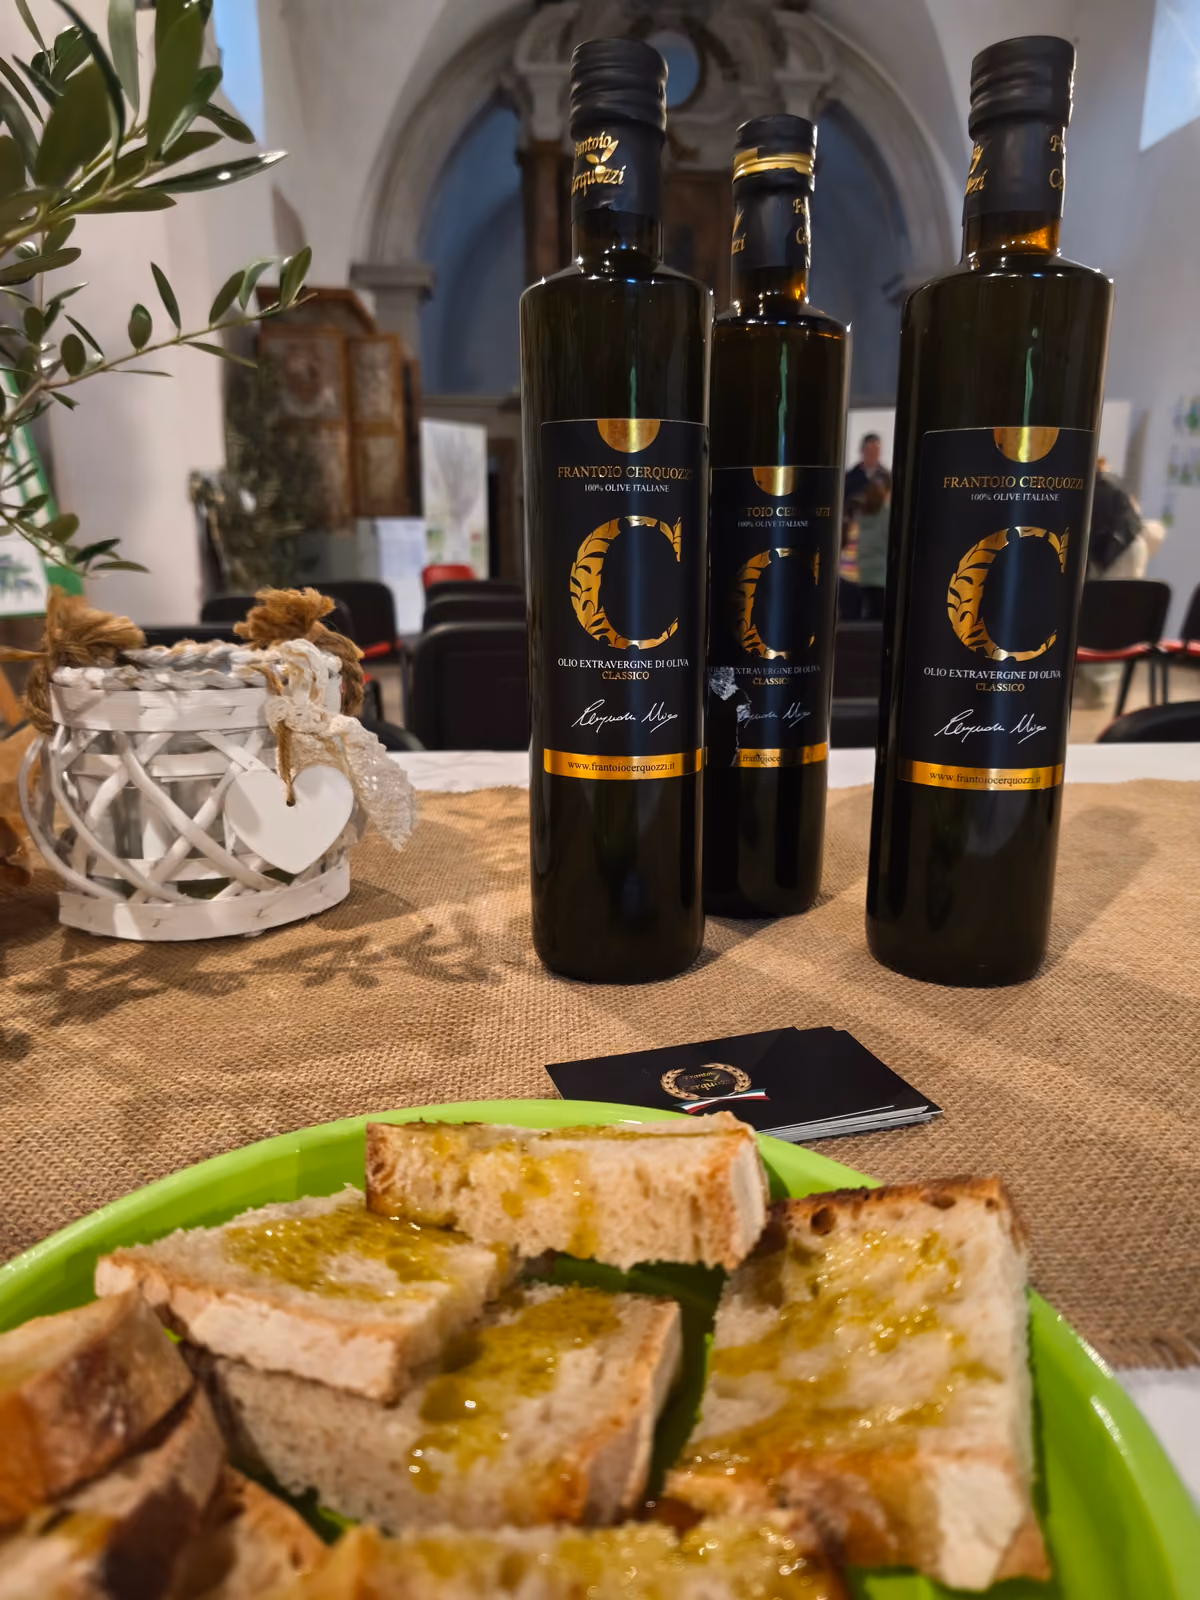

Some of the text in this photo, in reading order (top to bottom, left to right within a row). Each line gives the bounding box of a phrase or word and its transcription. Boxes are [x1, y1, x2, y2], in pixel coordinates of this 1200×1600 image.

[557, 465, 622, 478] FRANTOIO
[584, 483, 670, 493] 100% OLIVE ITALIANE
[943, 475, 1084, 491] FRANTOIO CERQUOZZI
[970, 492, 1060, 502] 100% OLIVE ITALIANE
[755, 520, 777, 529] OLIVE
[778, 520, 809, 528] ITALIANE
[557, 657, 690, 670] OLIO EXTRAVERGINE DI OLIVA
[601, 670, 650, 681] CLASSICO
[733, 666, 793, 676] XTRAVERGINE
[923, 666, 1061, 680] OLIO EXTRAVERGINE DI OLIVA
[975, 682, 1025, 693] CLASSICO
[567, 759, 675, 774] www.frantoiocerquozzi.it
[929, 770, 1041, 787] www.frantoiocerquozzi.it
